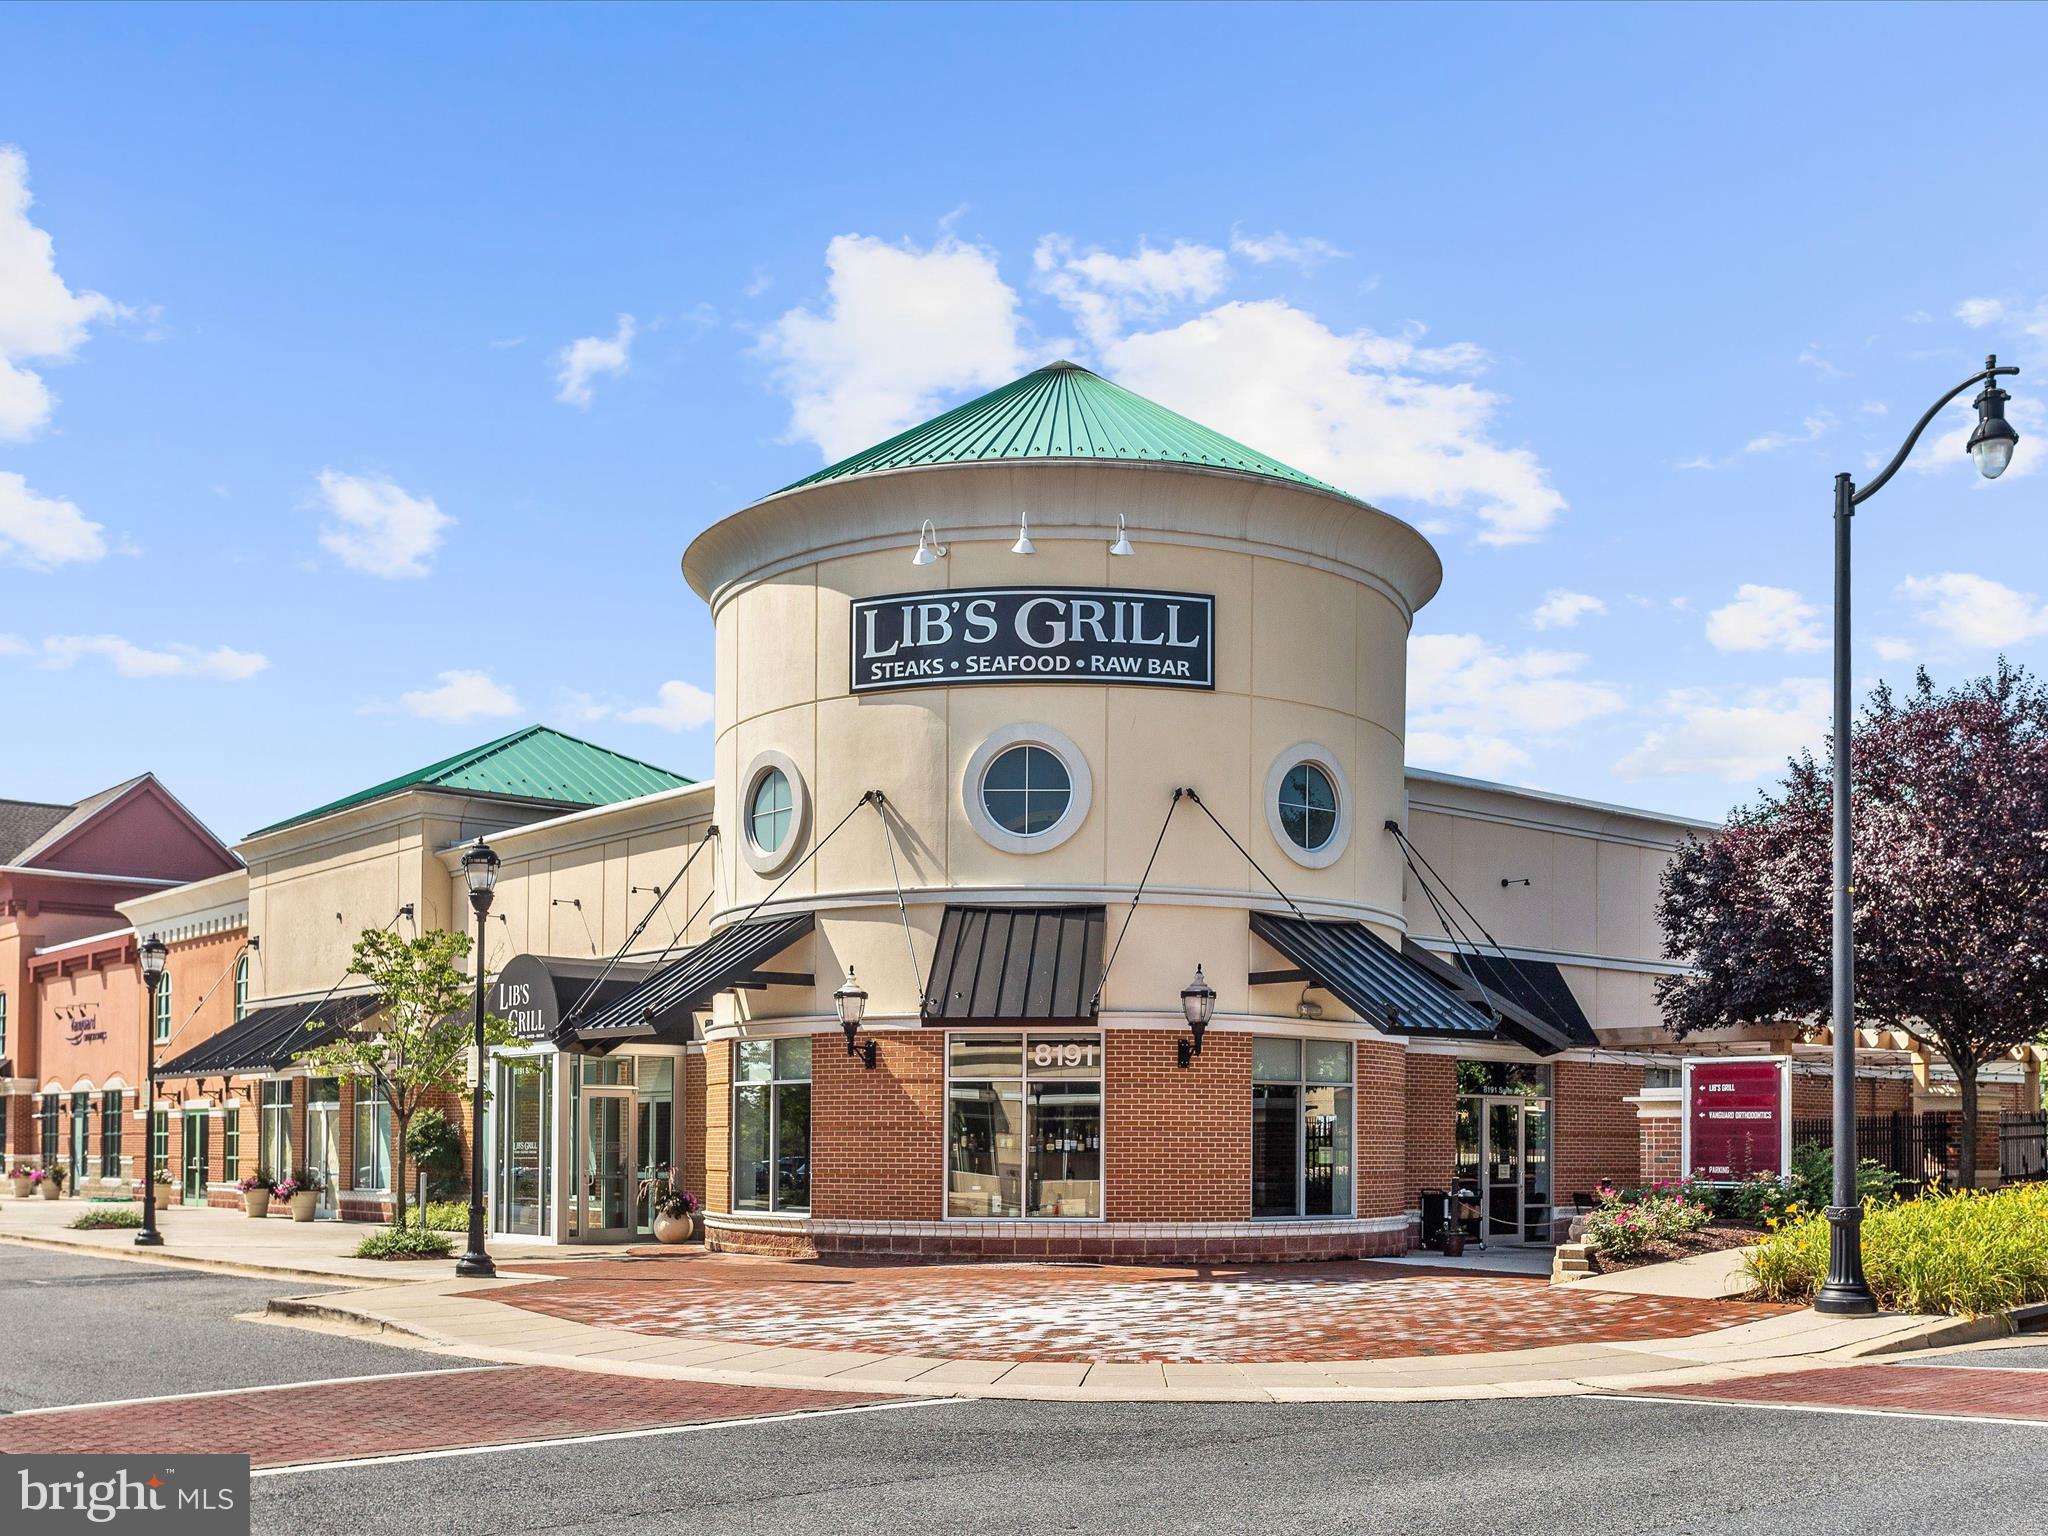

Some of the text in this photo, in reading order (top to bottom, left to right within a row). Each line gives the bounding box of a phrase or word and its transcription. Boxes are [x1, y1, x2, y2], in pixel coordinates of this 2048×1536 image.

[863, 598, 1200, 659] LIB'S GRILL
[871, 655, 1190, 680] STEAKS SEAFOOD RAW BAR
[500, 983, 530, 1010] LIB'S
[508, 1010, 546, 1037] GRILL
[1035, 1044, 1093, 1066] 8191
[1709, 1084, 1735, 1092] LIB'S GRILL
[1709, 1111, 1735, 1119] VANGUARD
[1709, 1166, 1730, 1174] PARKING
